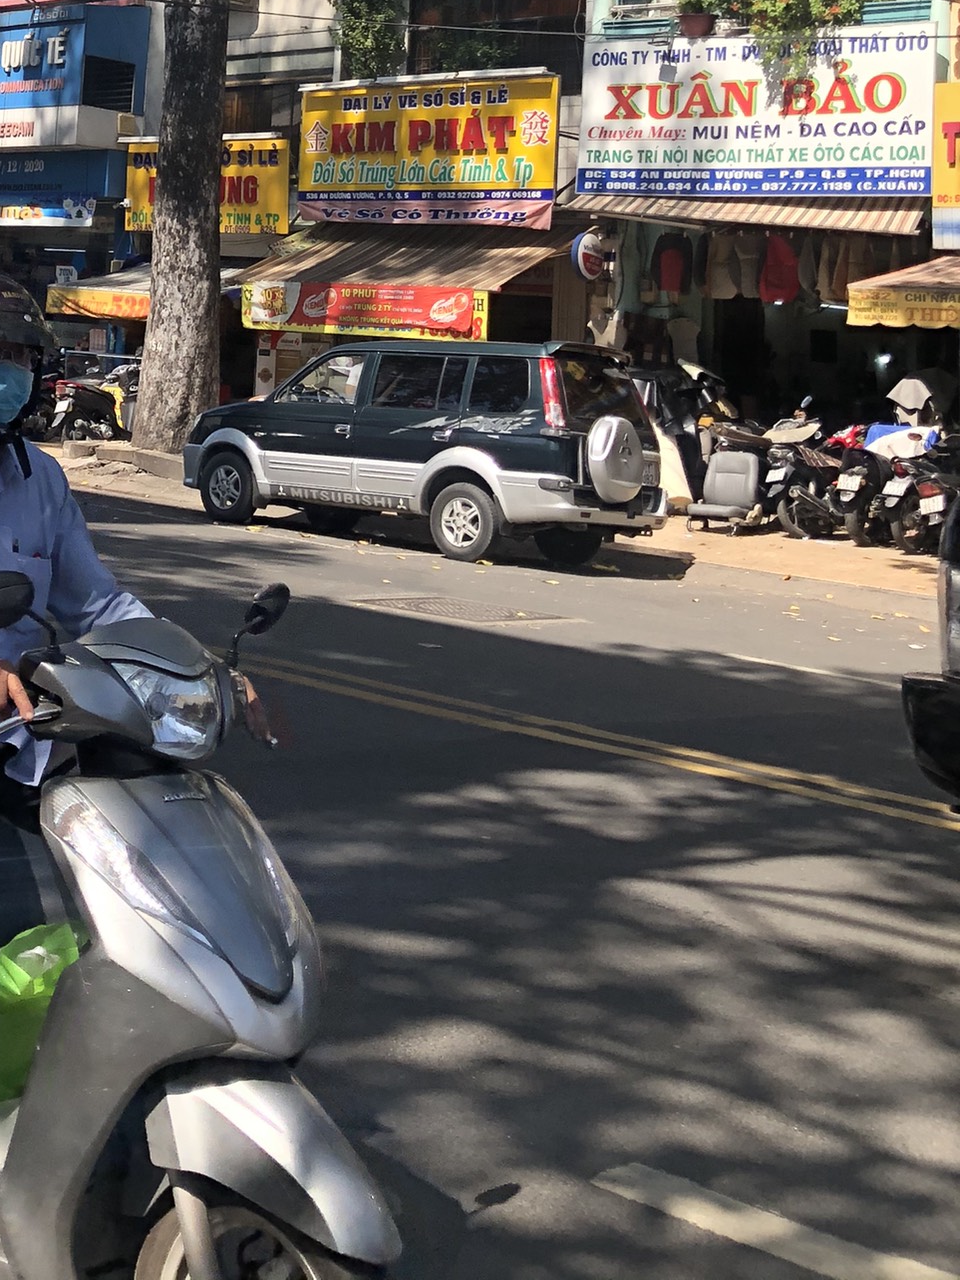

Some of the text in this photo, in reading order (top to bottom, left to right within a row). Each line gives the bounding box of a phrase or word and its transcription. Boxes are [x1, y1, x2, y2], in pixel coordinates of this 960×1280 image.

[2, 30, 42, 72] QUỐC
[46, 27, 70, 65] TẾ
[592, 48, 628, 66] CÔNG
[632, 50, 648, 64] TY
[654, 48, 691, 64] TNHH
[706, 46, 727, 62] TM
[849, 31, 890, 54] THẤT
[896, 31, 928, 52] ÔTÔ
[343, 84, 508, 115] ĐẠI LÝ VÉ SỐ SỈ & LẺ
[604, 59, 907, 120] XUÂN BẢO
[306, 121, 328, 153] 金
[331, 108, 516, 154] KIM PHÁT
[588, 126, 642, 141] Chuyên
[648, 126, 687, 142] May:
[692, 126, 728, 140] MUI
[736, 120, 781, 142] NỆM
[834, 122, 877, 136] CAO
[884, 114, 926, 136] CẤP
[237, 144, 254, 168] SỈ
[258, 143, 279, 167] LẺ
[587, 142, 926, 166] TRANG TRÍ NỘI NGOẠI THẤT XE ÔTÔ CÁC LOẠI
[24, 159, 44, 174] 2020
[312, 157, 533, 190] Đổi Số Trúng Lớn Các Tỉnh & Tp
[584, 170, 925, 179] ĐC: 534 AN DƯƠNG VƯƠNG P.9 Q.5 TP.HCM
[319, 192, 328, 200] AN
[584, 180, 925, 192] ĐT: 0908.240.634 (A.BẢO) 037.777.1139 (C.XUÂN)
[226, 208, 250, 226] TỈNH
[255, 214, 263, 226] &
[264, 213, 280, 226] TP
[321, 206, 527, 222] Vé Số Có Thưởng
[341, 288, 350, 298] 10
[352, 286, 378, 298] PHÚT
[905, 293, 926, 302] CHI
[378, 304, 384, 312] 2
[290, 488, 393, 508] MITSUBISHI
